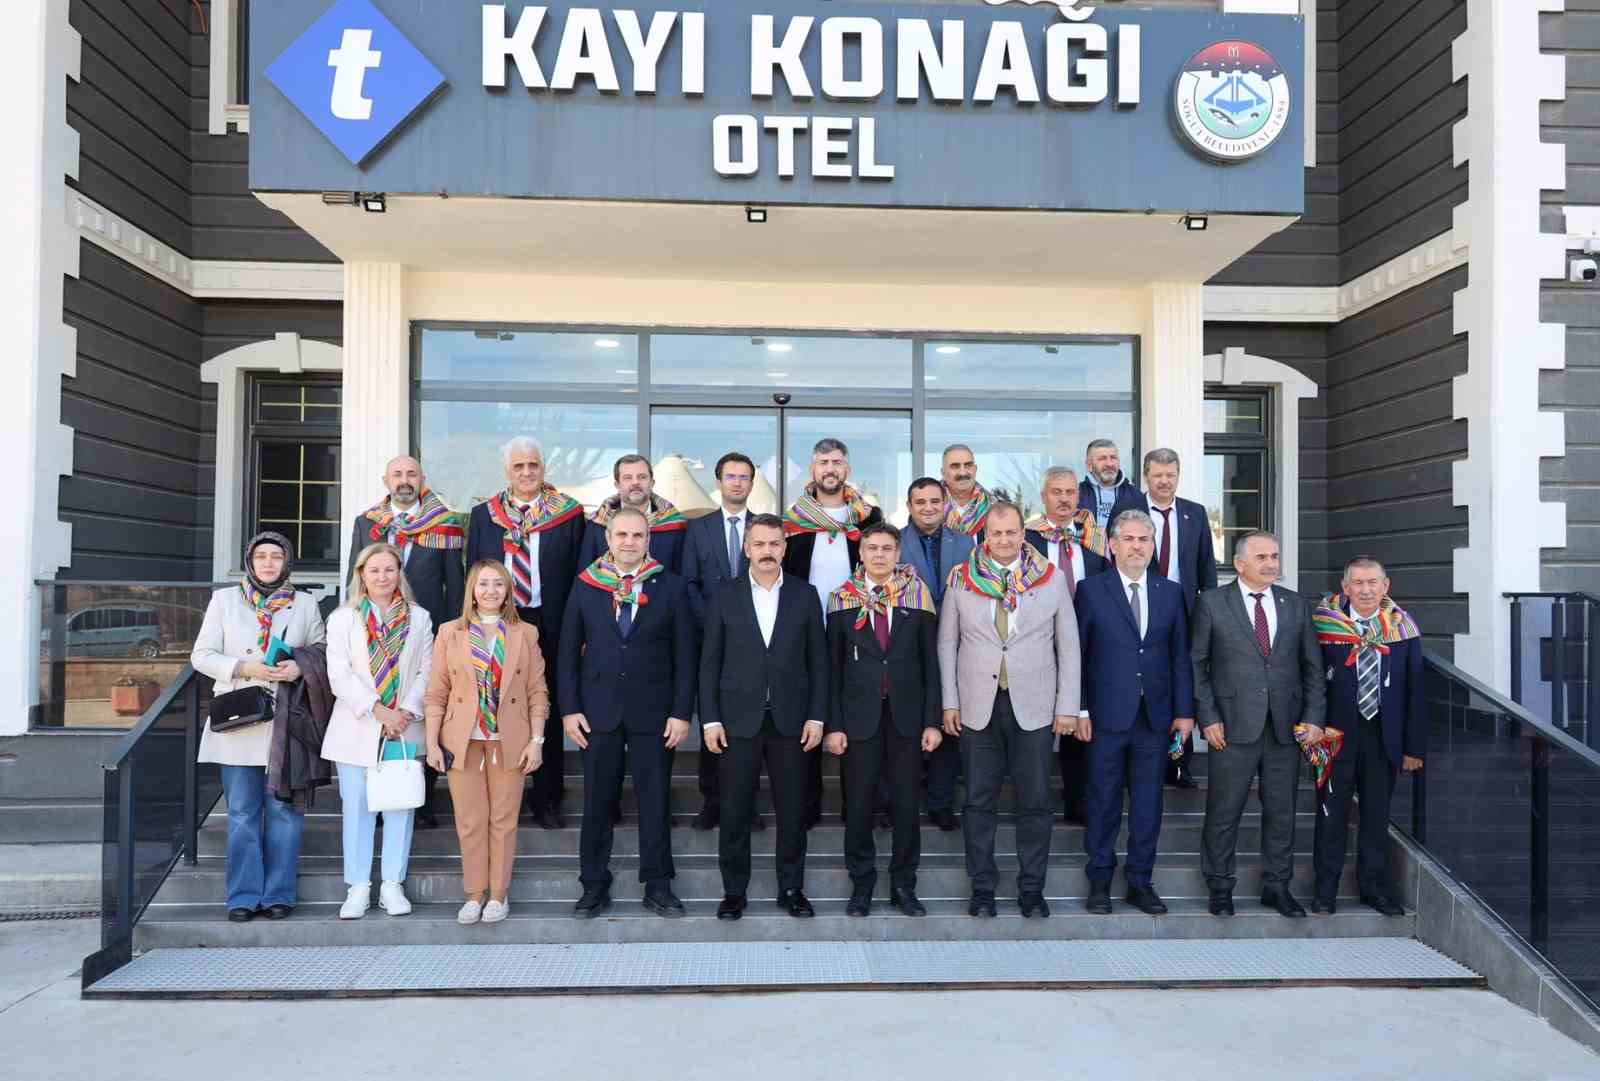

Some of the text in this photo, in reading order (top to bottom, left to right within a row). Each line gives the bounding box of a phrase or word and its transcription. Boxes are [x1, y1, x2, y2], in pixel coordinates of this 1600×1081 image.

[327, 28, 382, 120] t
[482, 4, 1140, 105] KAYI KONAĞI
[713, 114, 895, 179] OTEL
